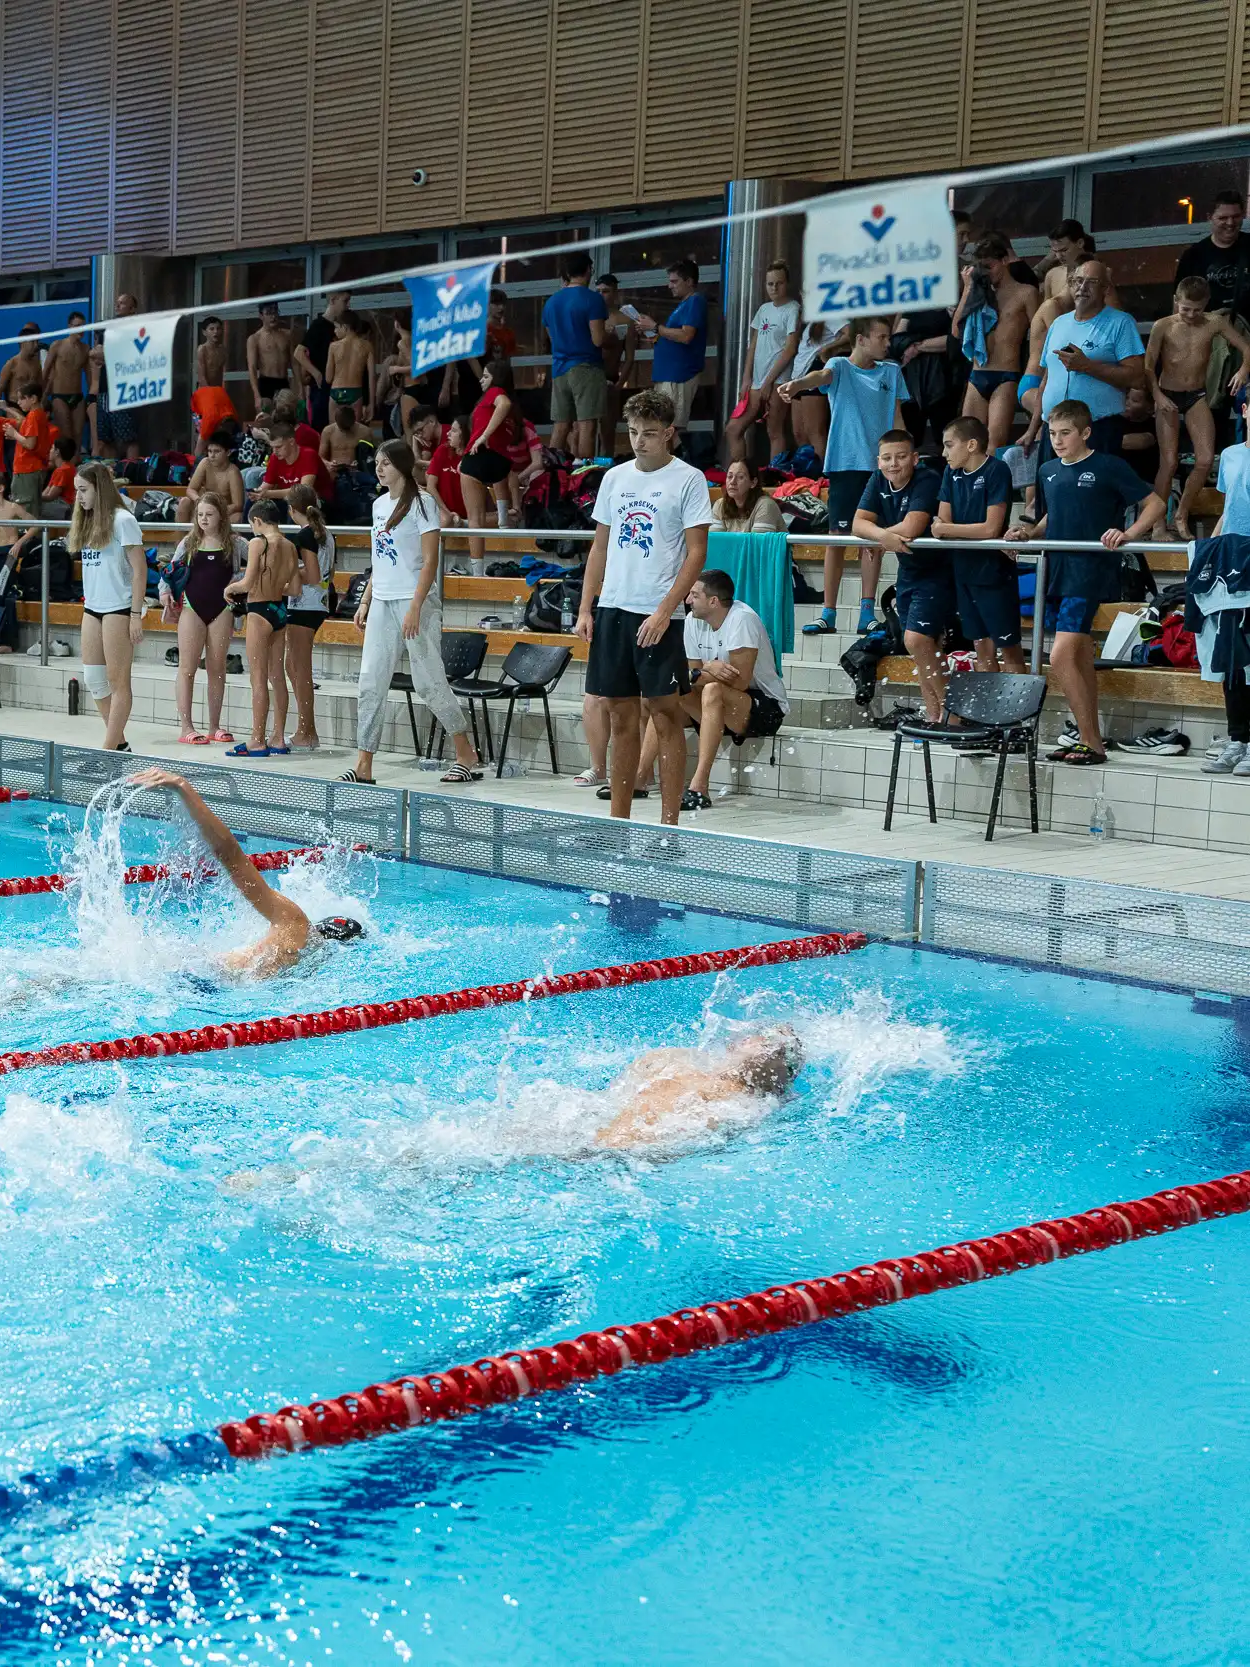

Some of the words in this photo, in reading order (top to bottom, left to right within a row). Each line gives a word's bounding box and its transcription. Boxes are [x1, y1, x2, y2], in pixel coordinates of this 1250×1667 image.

[897, 240, 942, 263] klub
[817, 273, 942, 312] Zadar
[416, 329, 481, 370] Zadar
[116, 377, 167, 406] Zadar
